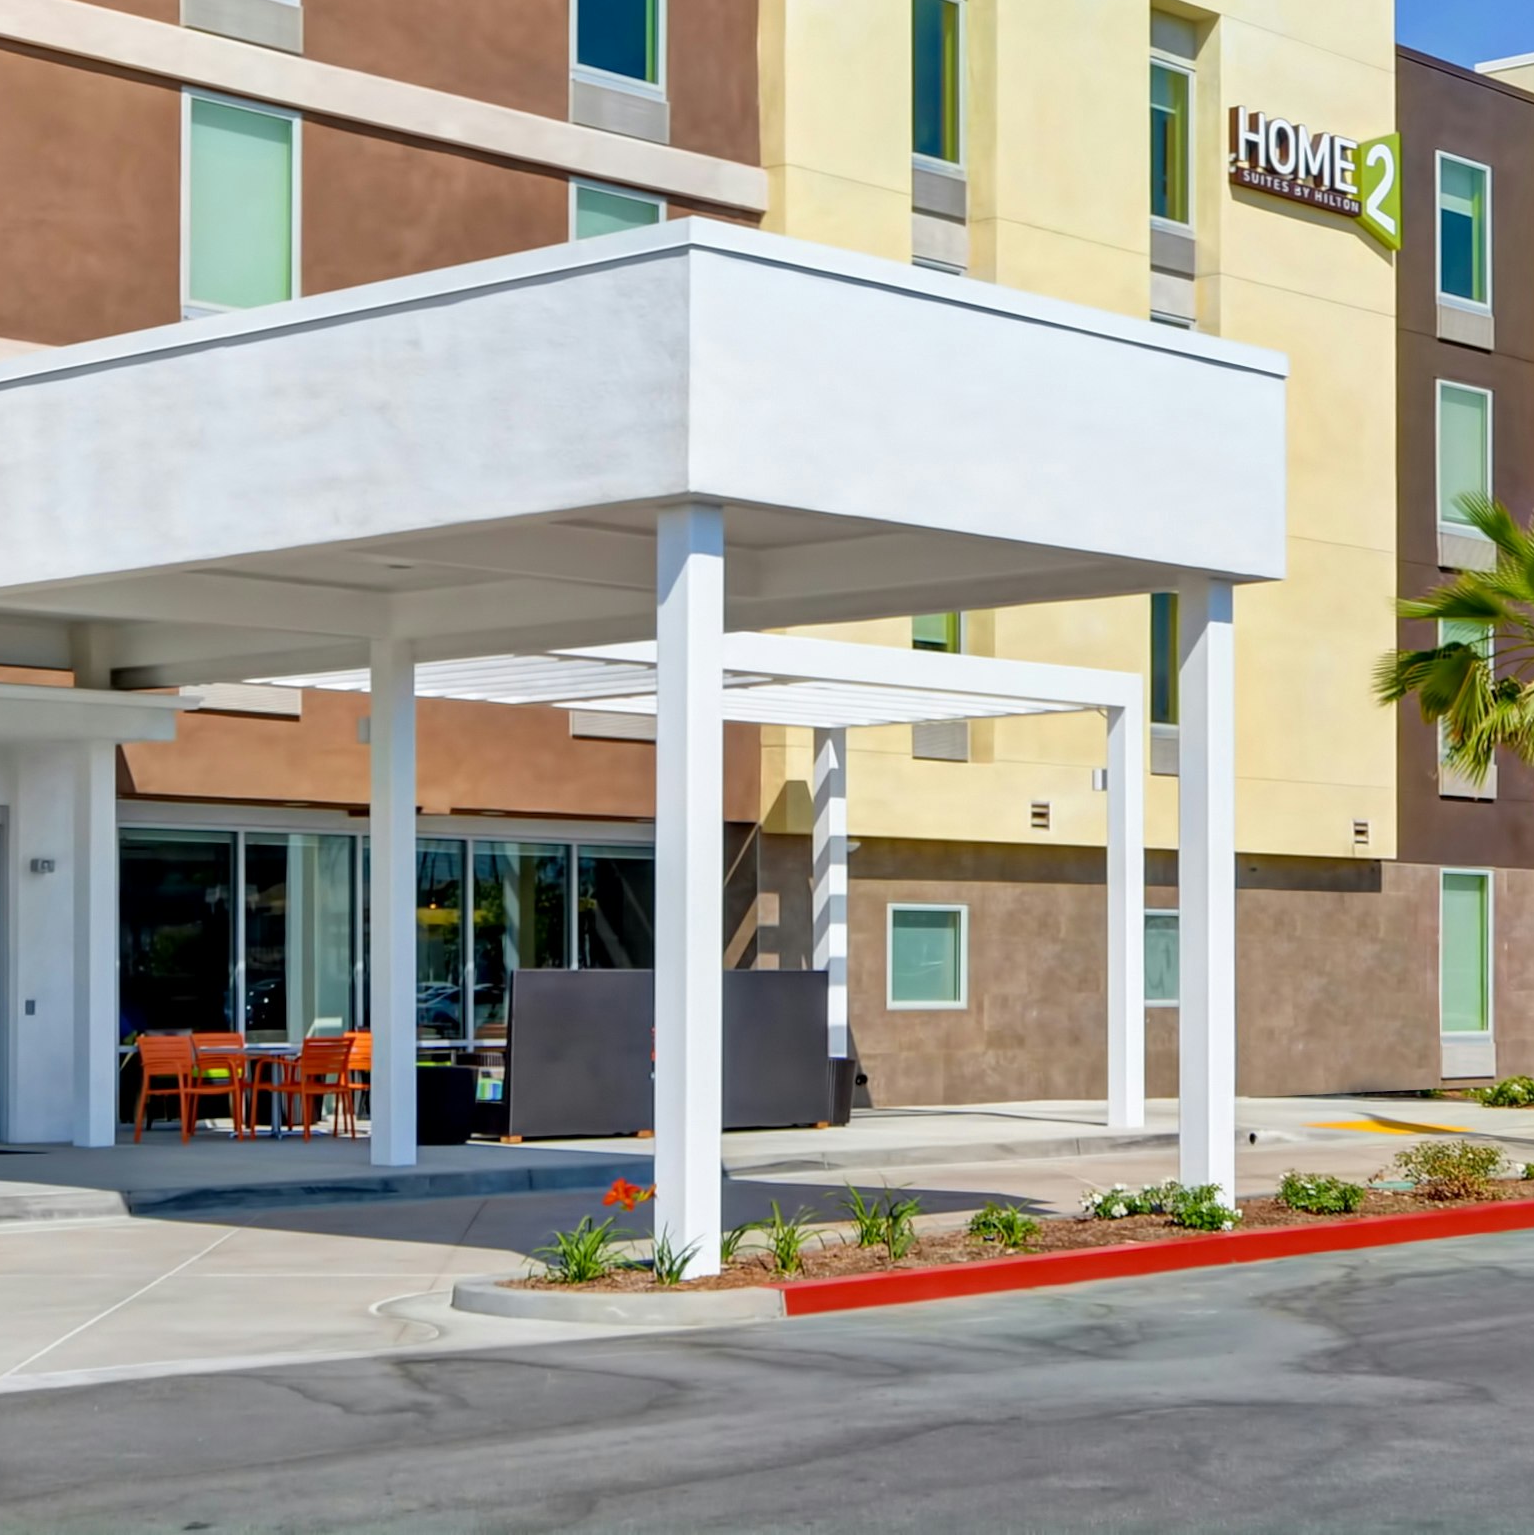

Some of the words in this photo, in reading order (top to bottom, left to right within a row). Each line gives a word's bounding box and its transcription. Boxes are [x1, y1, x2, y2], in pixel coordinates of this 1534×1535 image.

[1235, 105, 1358, 195] HOME
[1366, 143, 1396, 236] 2
[1242, 170, 1290, 193] SUITES
[1293, 186, 1310, 199] BY
[1314, 190, 1359, 213] HILTON
